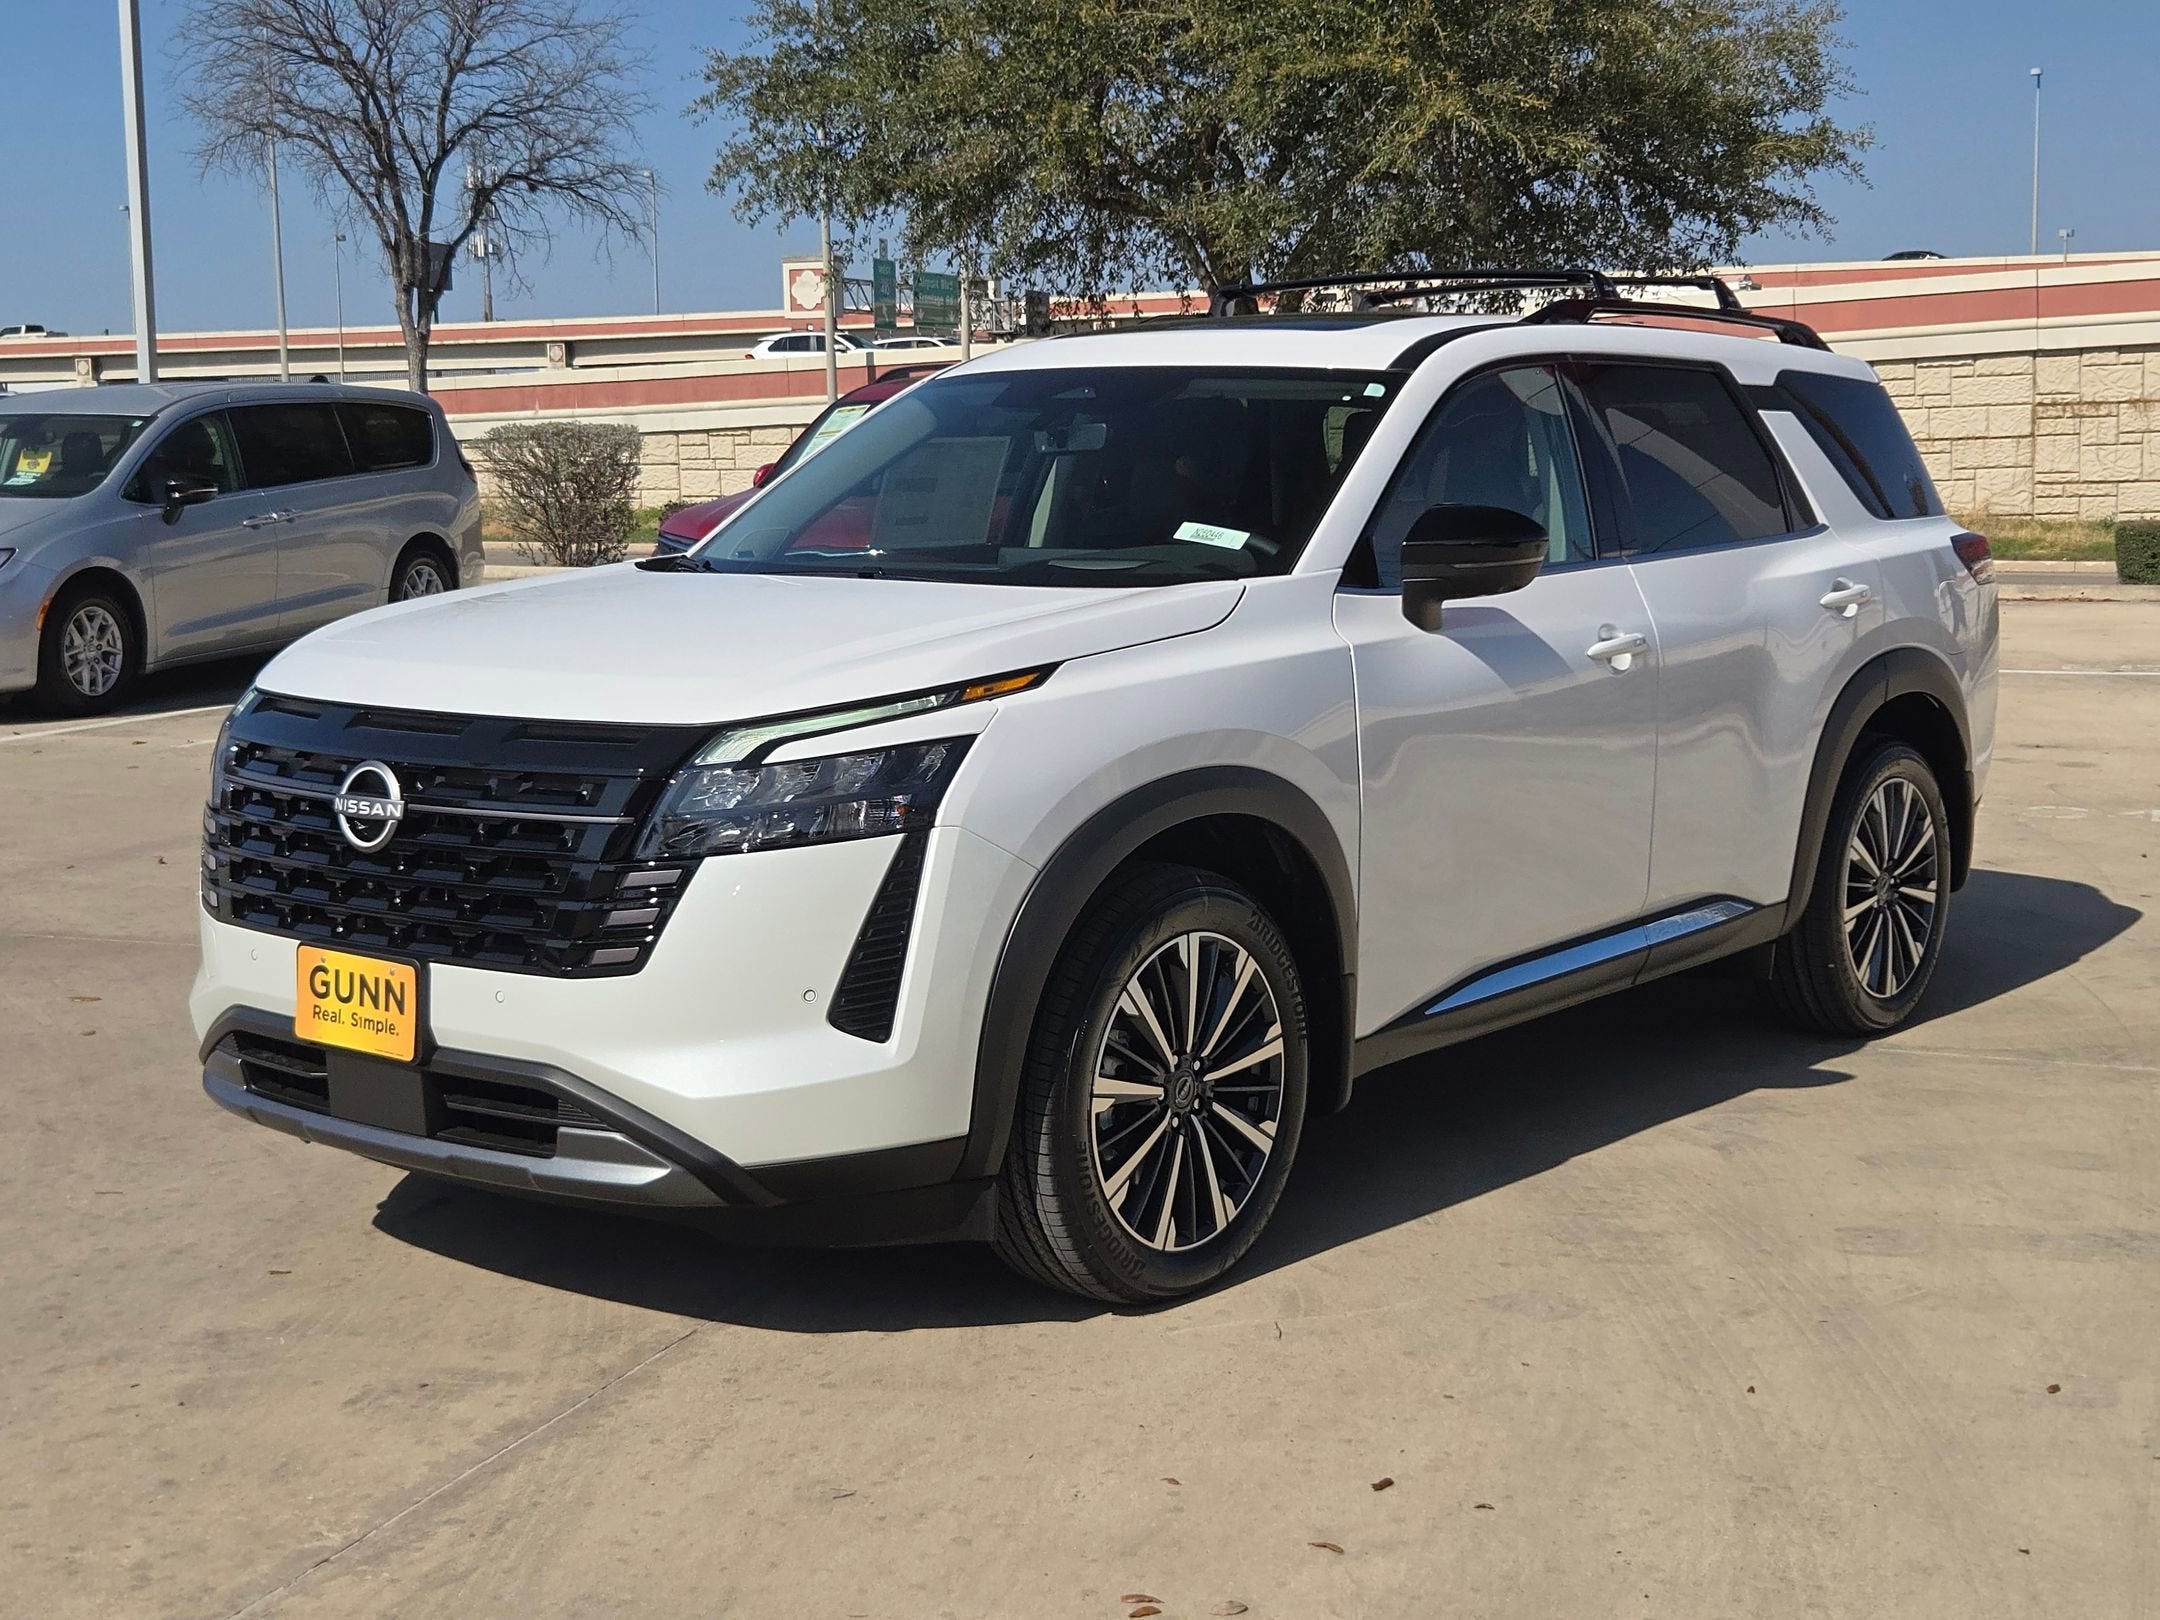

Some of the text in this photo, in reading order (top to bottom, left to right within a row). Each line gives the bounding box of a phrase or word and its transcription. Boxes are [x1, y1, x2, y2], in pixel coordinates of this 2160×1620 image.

[334, 797, 402, 817] NISSAN
[309, 964, 405, 1016] GUNN
[312, 1004, 345, 1025] Real.
